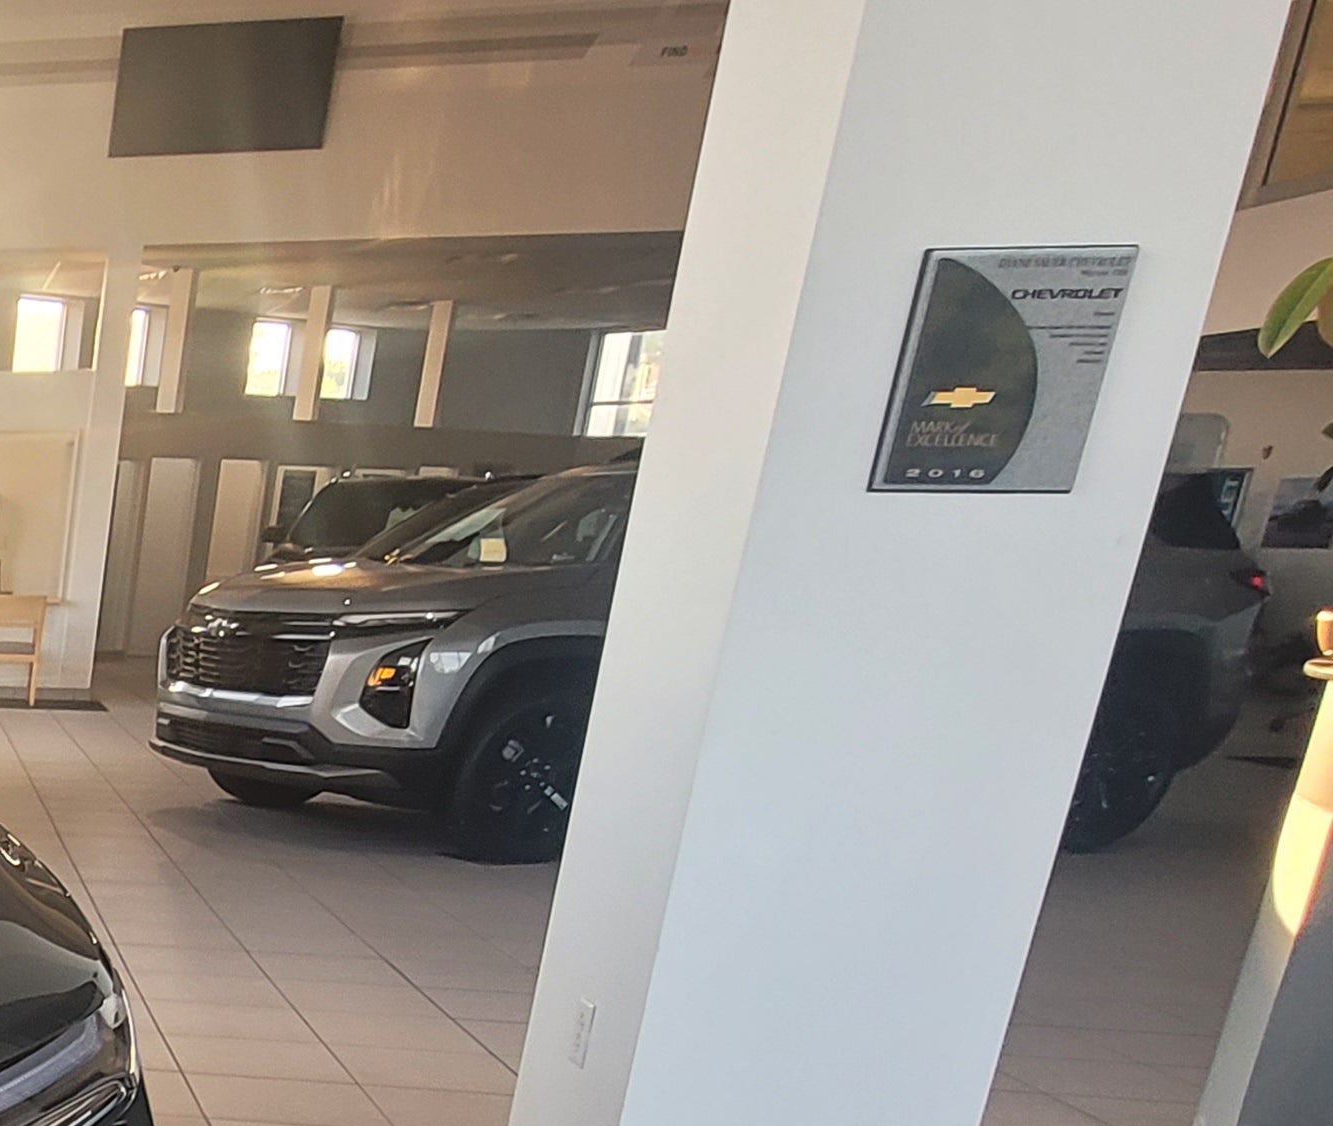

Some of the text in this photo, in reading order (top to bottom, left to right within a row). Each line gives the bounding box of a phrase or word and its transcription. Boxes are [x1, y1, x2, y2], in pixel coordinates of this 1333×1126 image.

[1011, 288, 1123, 300] CHEVROLET
[911, 420, 956, 433] MARK
[906, 432, 999, 447] EXCELLENCE
[905, 468, 986, 479] 2016
